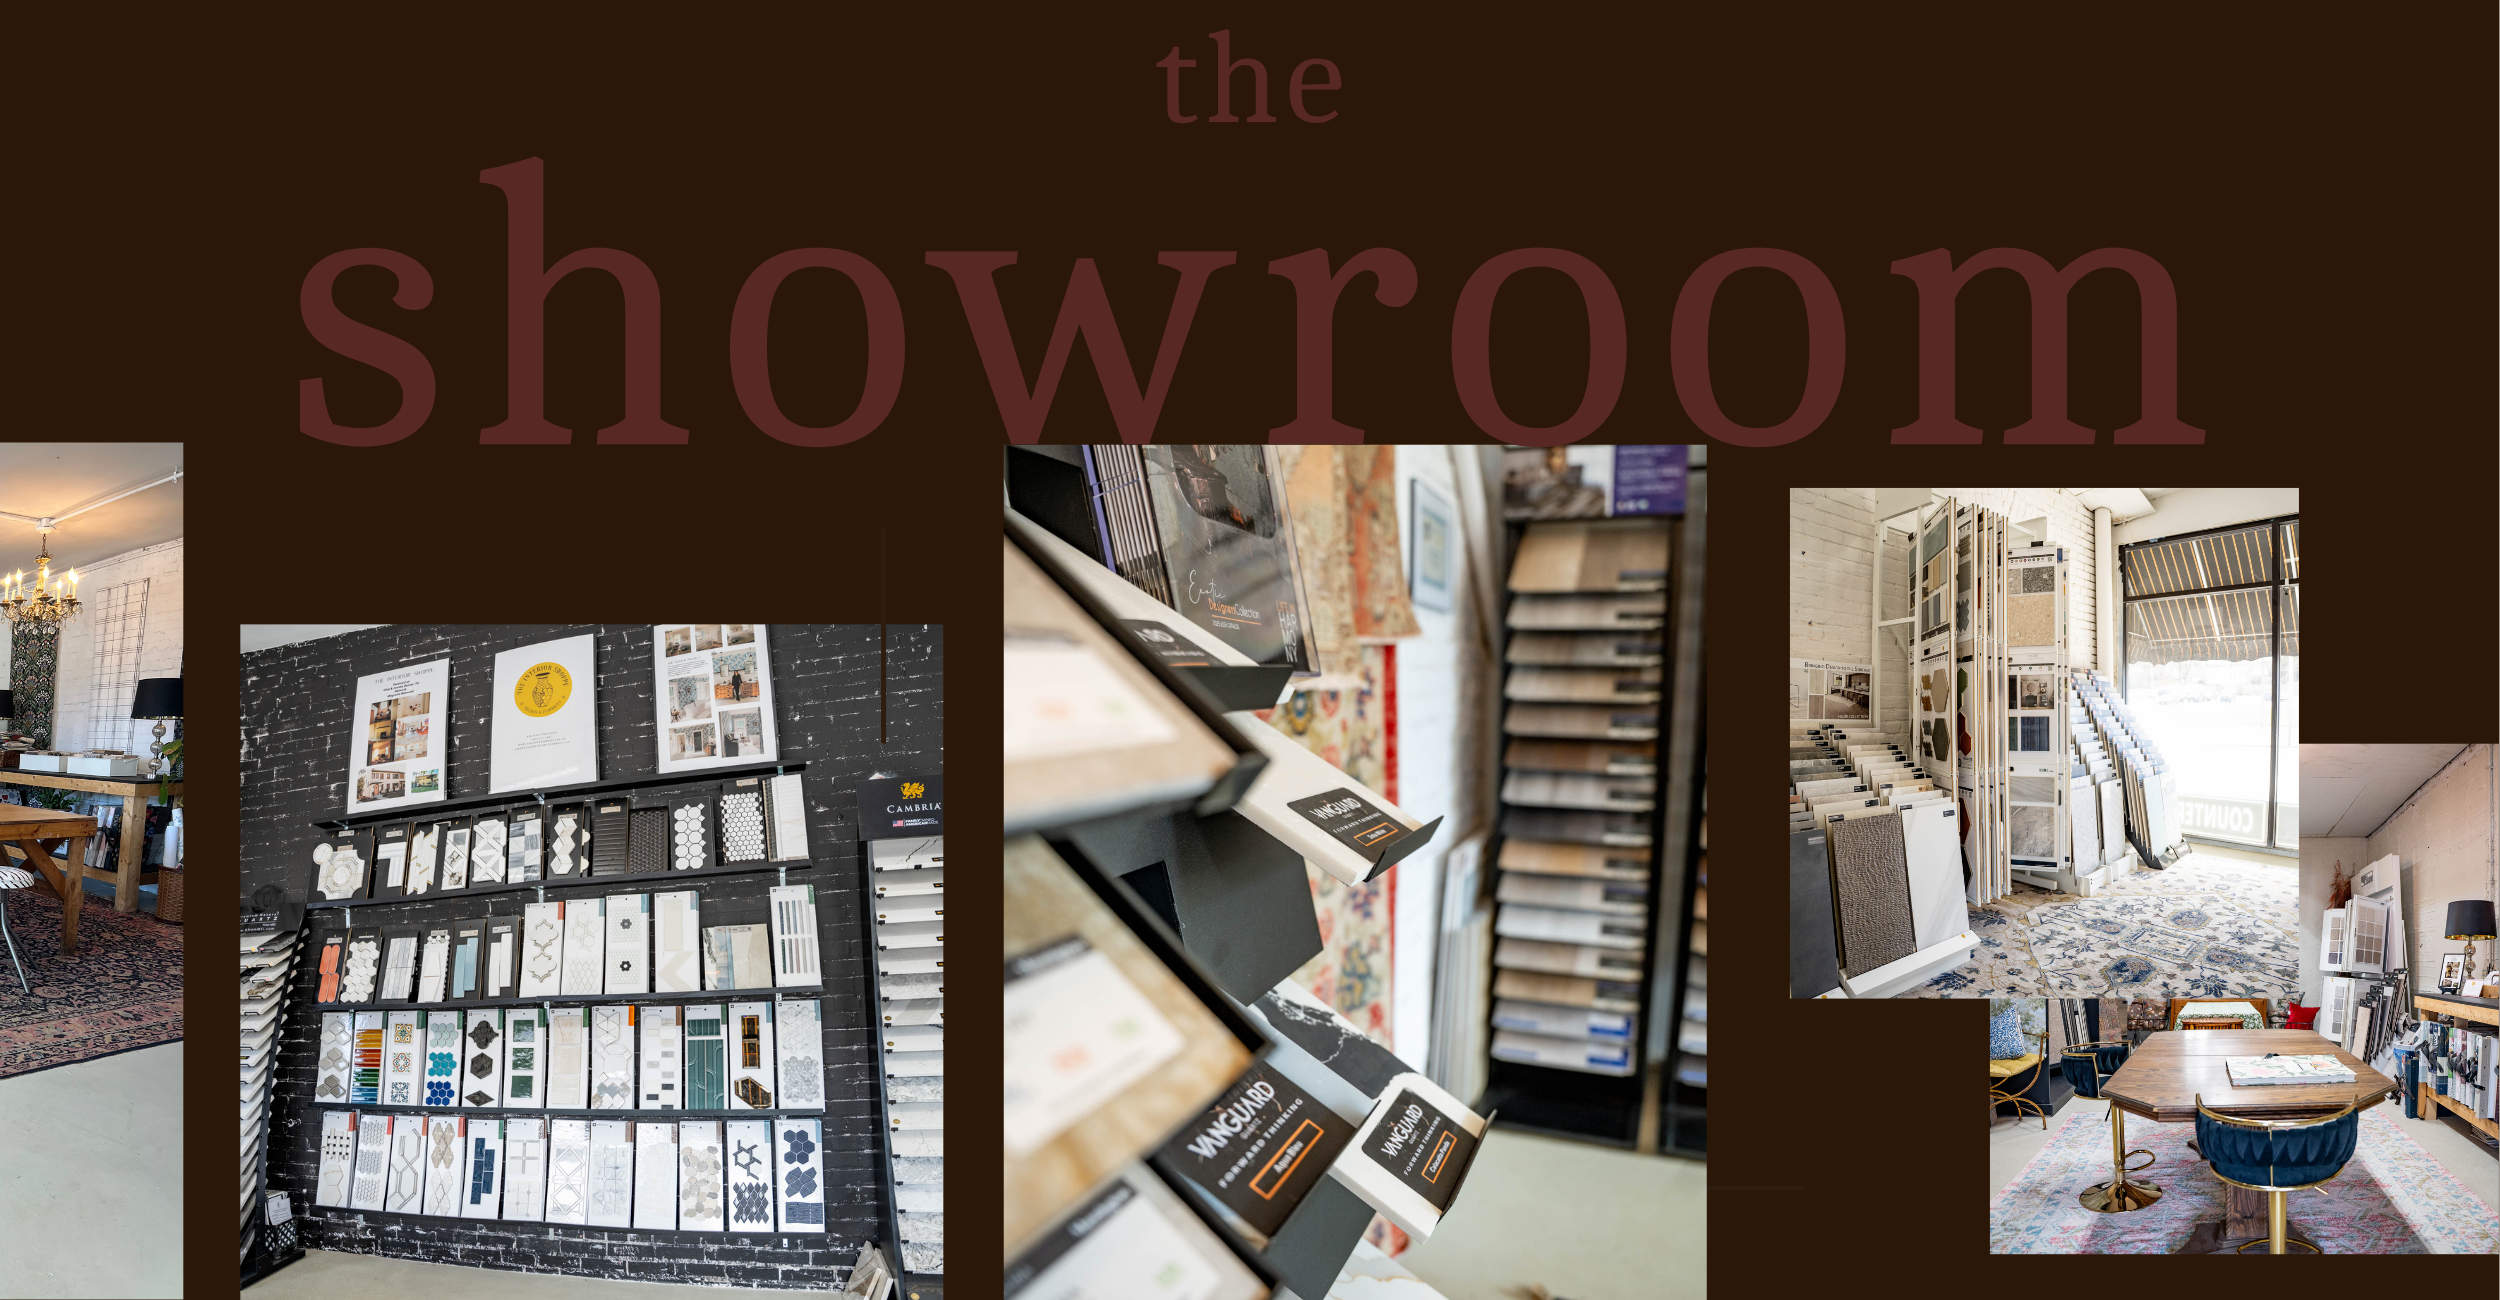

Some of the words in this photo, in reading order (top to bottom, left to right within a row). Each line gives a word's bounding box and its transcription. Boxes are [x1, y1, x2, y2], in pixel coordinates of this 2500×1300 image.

[1278, 612, 1298, 631] HAR
[1281, 628, 1297, 646] MO
[1285, 645, 1298, 663] NY
[386, 672, 411, 682] INTERIOR
[413, 667, 434, 677] SHOPPE
[516, 682, 525, 696] THE
[522, 664, 552, 682] INTERIOR
[553, 666, 569, 687] SHOPPE
[887, 803, 941, 813] CAMBRIA
[1309, 797, 1361, 820] VANGUARD
[1333, 820, 1359, 833] FORWARD
[1359, 812, 1382, 824] THINKING
[1187, 1081, 1275, 1159] VANGUARD
[1380, 1104, 1423, 1157] VANGUARD
[1218, 1138, 1266, 1189] FORWARD
[1263, 1098, 1304, 1140] THINKING
[1403, 1144, 1425, 1176] FORWARD
[1423, 1116, 1442, 1145] THINKING
